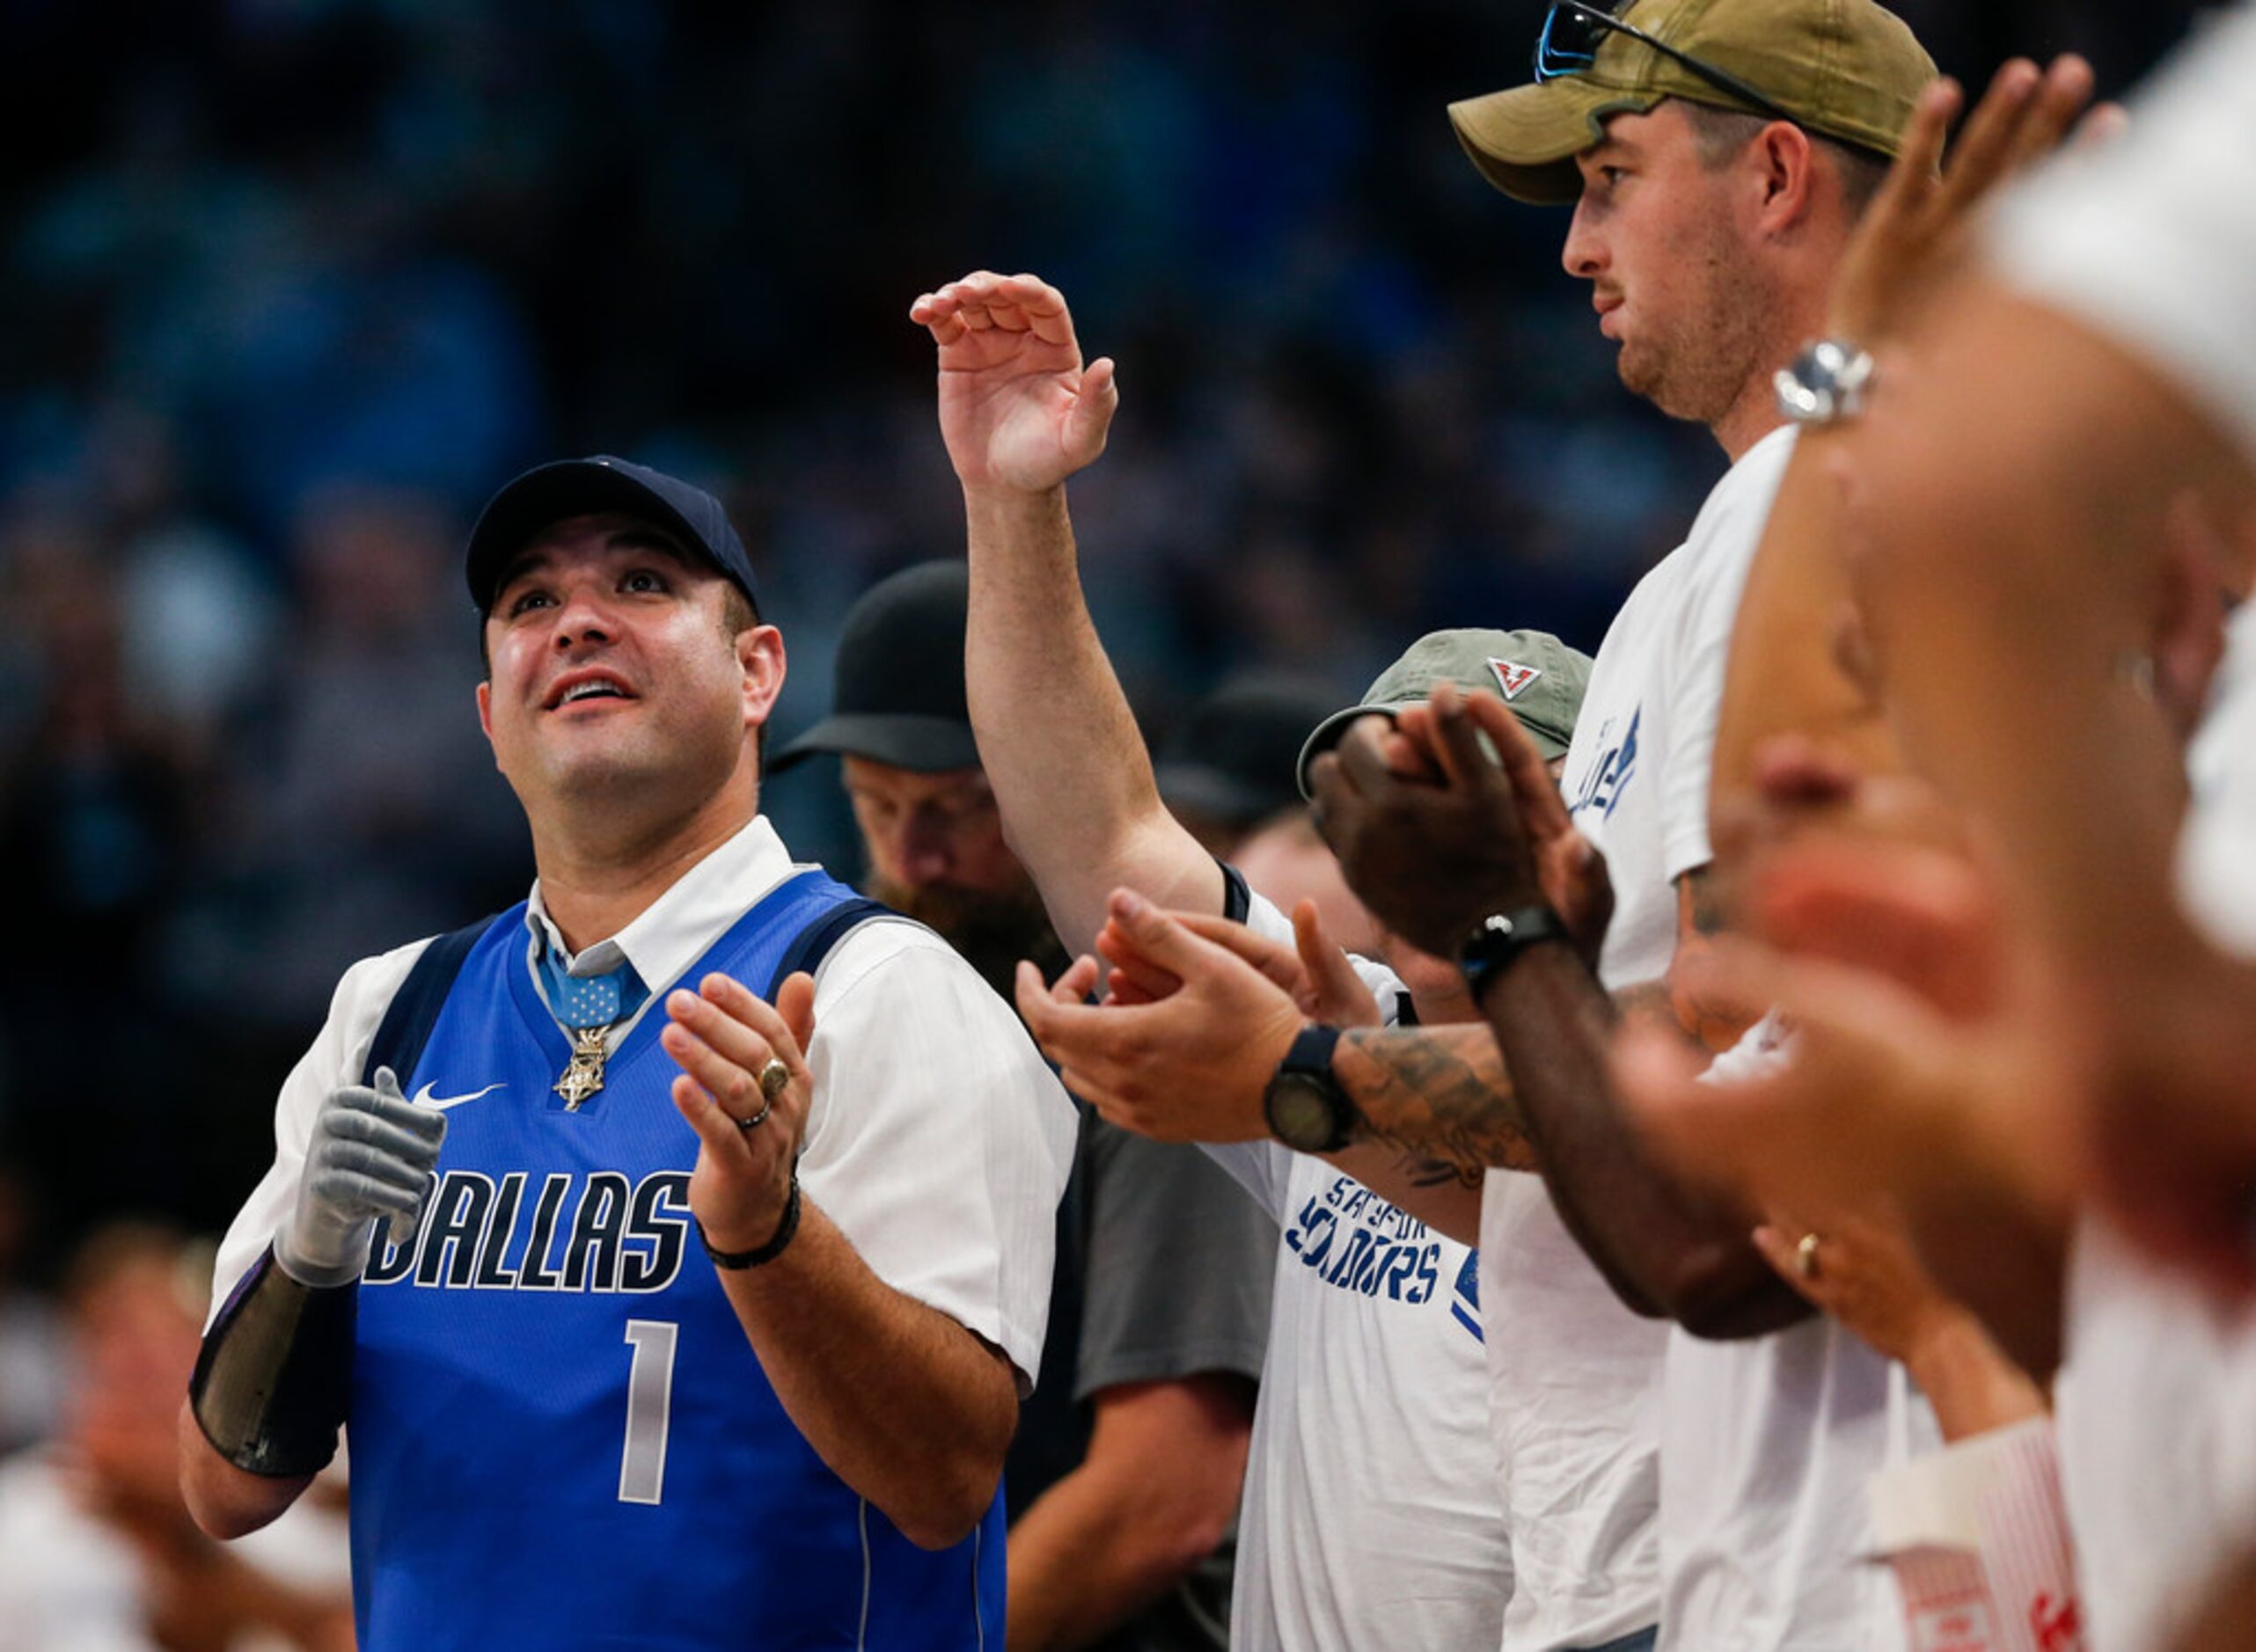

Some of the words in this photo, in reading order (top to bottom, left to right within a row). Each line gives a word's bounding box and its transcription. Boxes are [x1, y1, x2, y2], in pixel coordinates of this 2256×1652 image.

[361, 1170, 692, 1294] DALLAS
[1285, 1195, 1440, 1304] SODIERS
[619, 1319, 678, 1505] 1
